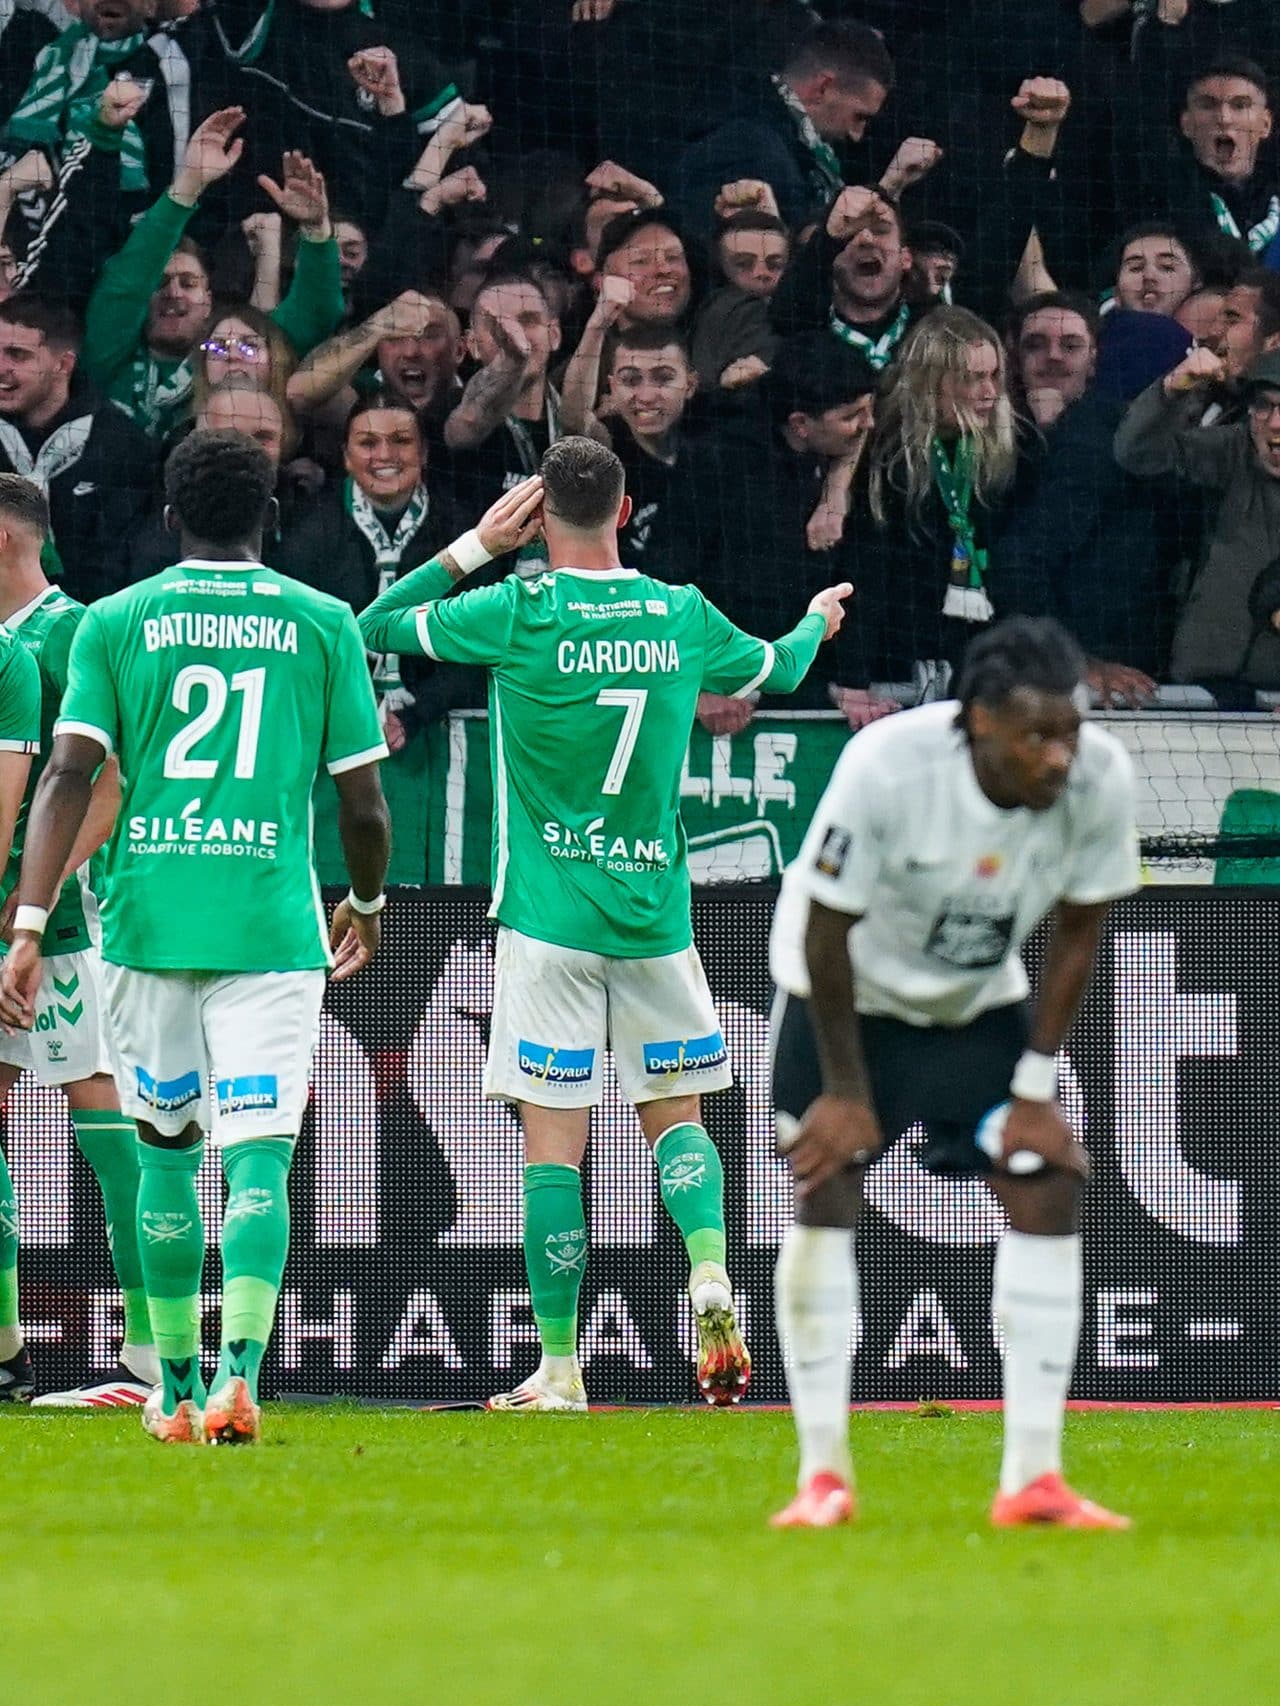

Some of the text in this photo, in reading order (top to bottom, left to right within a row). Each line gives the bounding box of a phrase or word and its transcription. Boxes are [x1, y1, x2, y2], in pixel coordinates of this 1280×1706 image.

[143, 612, 298, 655] BATUBINSIKA
[557, 639, 680, 674] CARDONA
[163, 664, 267, 779] 21
[595, 688, 649, 795] 7
[128, 842, 277, 860] ADAPTIVE ROBOTICS
